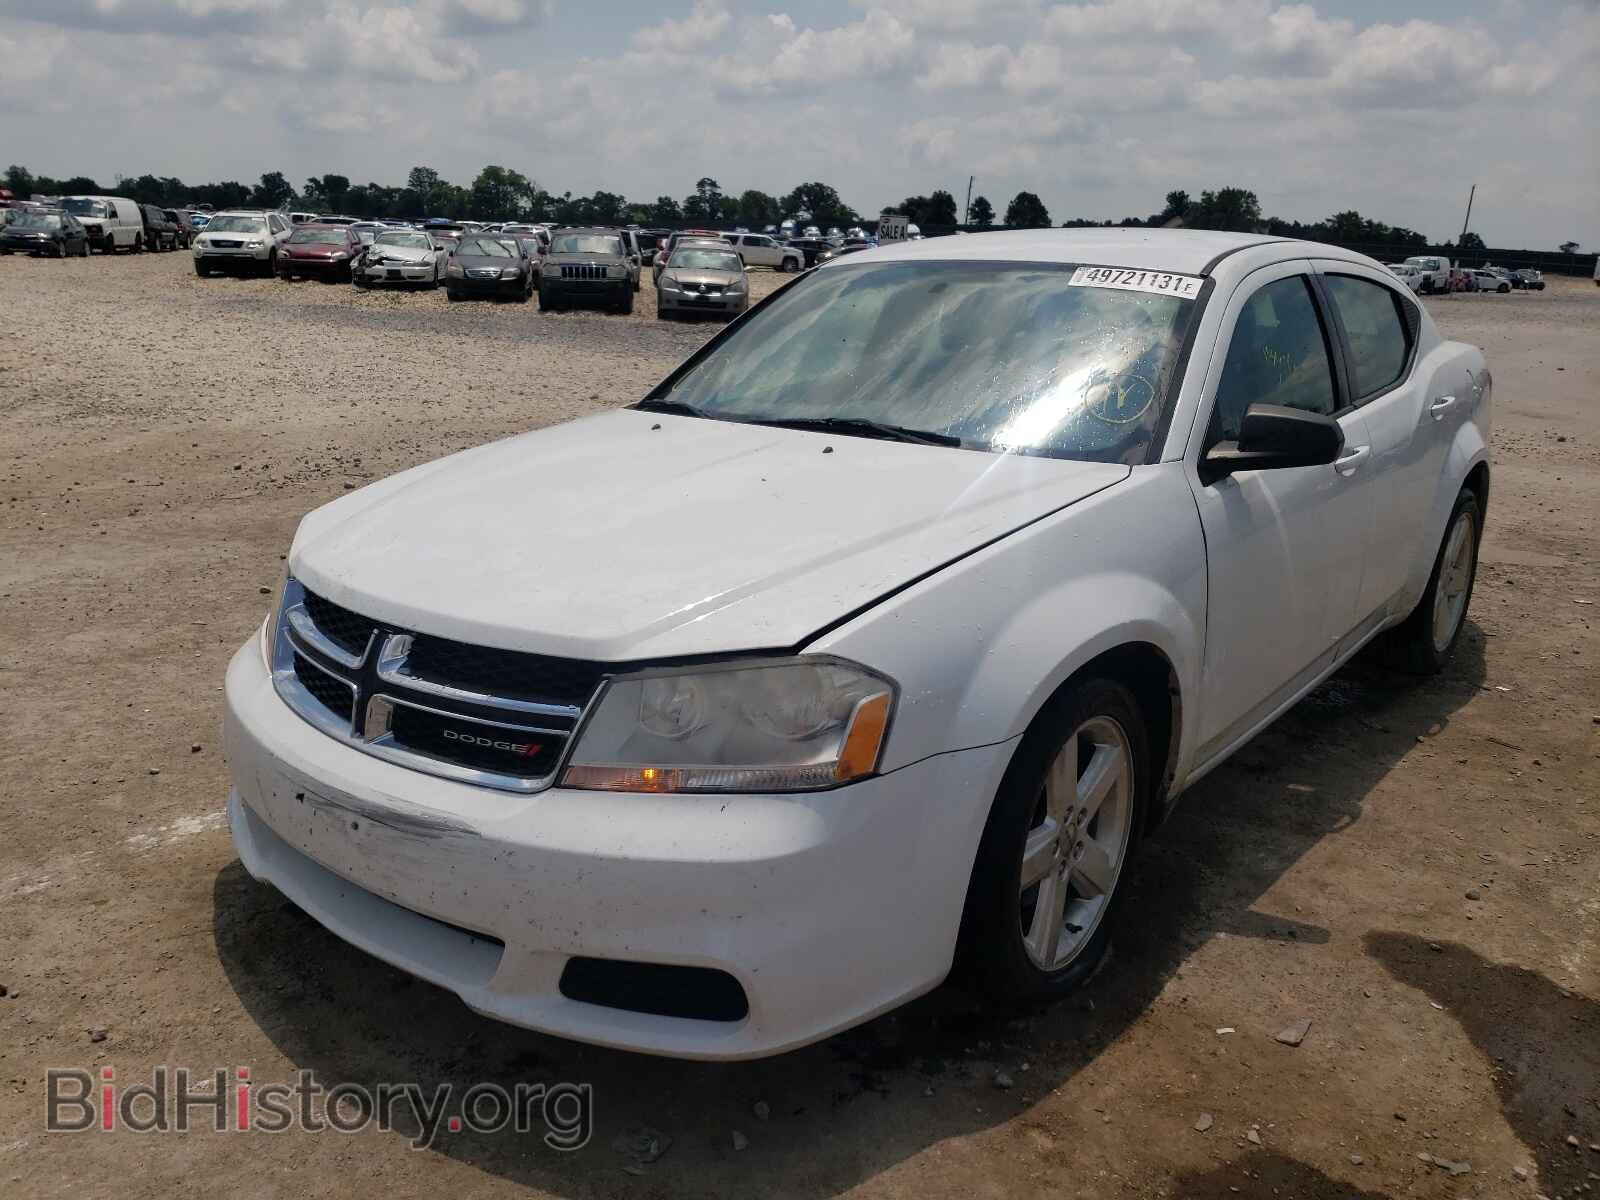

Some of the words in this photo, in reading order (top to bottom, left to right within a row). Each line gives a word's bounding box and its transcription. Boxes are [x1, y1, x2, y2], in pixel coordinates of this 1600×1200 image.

[881, 224, 898, 239] SALE
[1087, 268, 1183, 291] 49721131
[443, 729, 529, 753] DODGE
